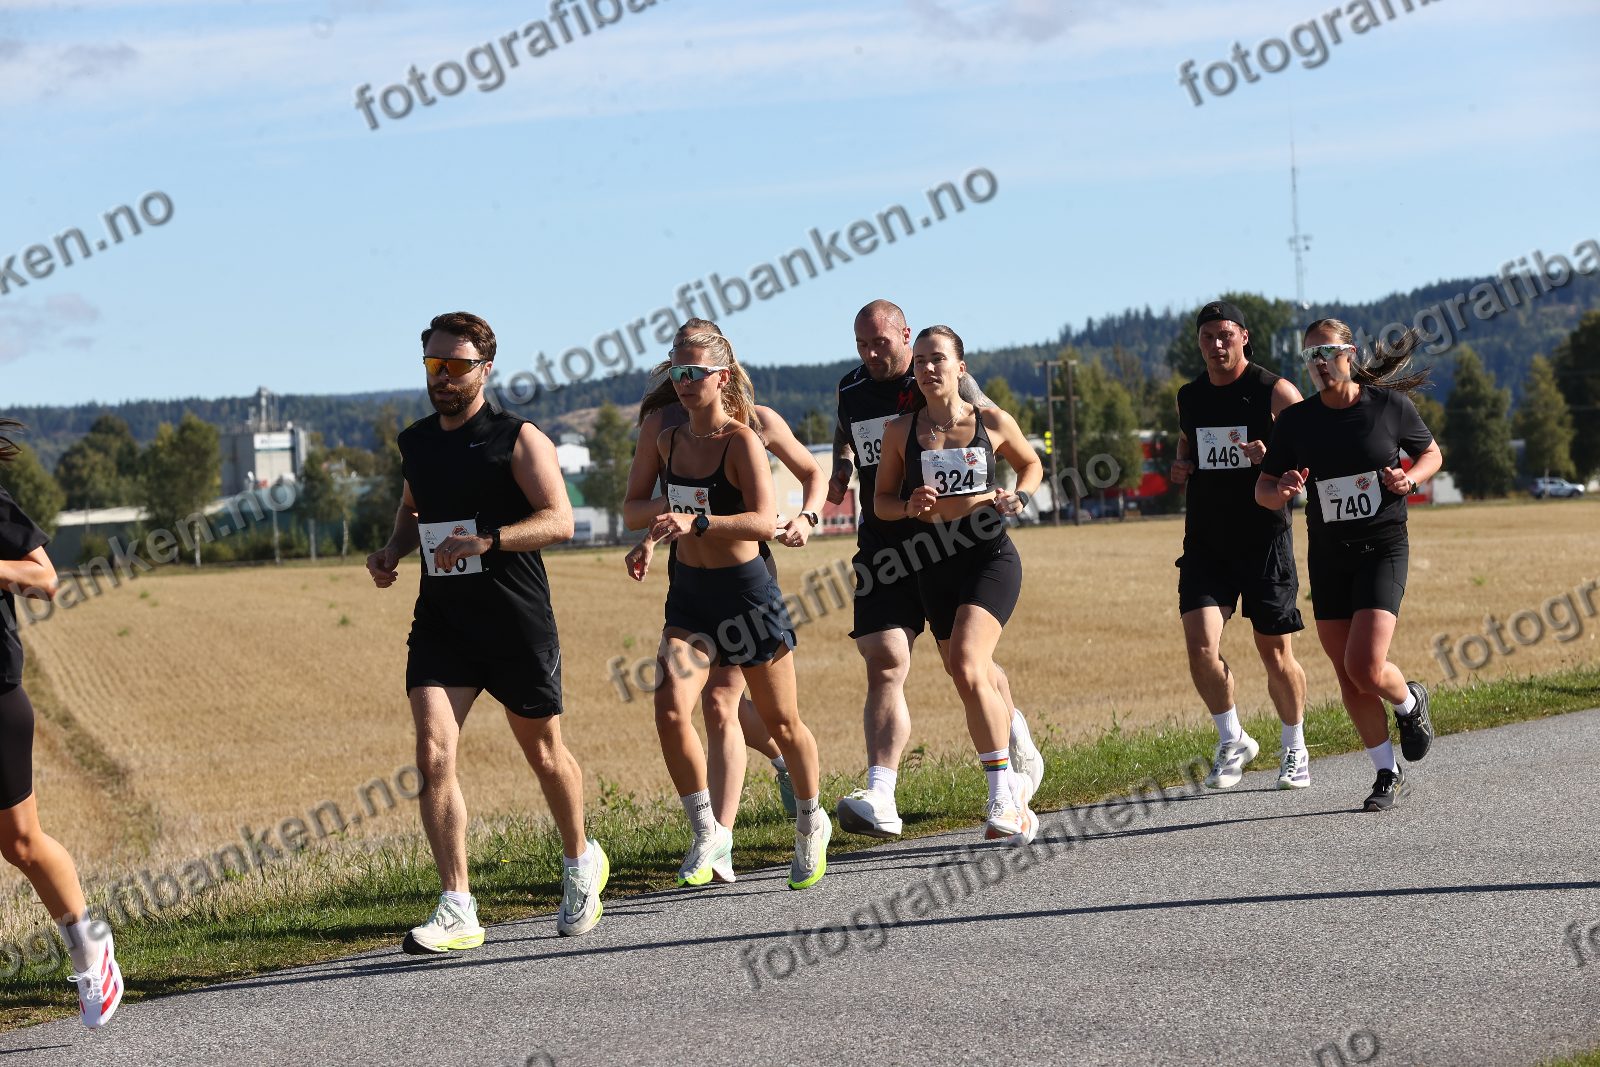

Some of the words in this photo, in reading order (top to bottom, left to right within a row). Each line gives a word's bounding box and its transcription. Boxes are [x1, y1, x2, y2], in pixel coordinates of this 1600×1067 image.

[1207, 446, 1239, 467] 446
[935, 469, 975, 494] 324
[1330, 493, 1372, 519] 740
